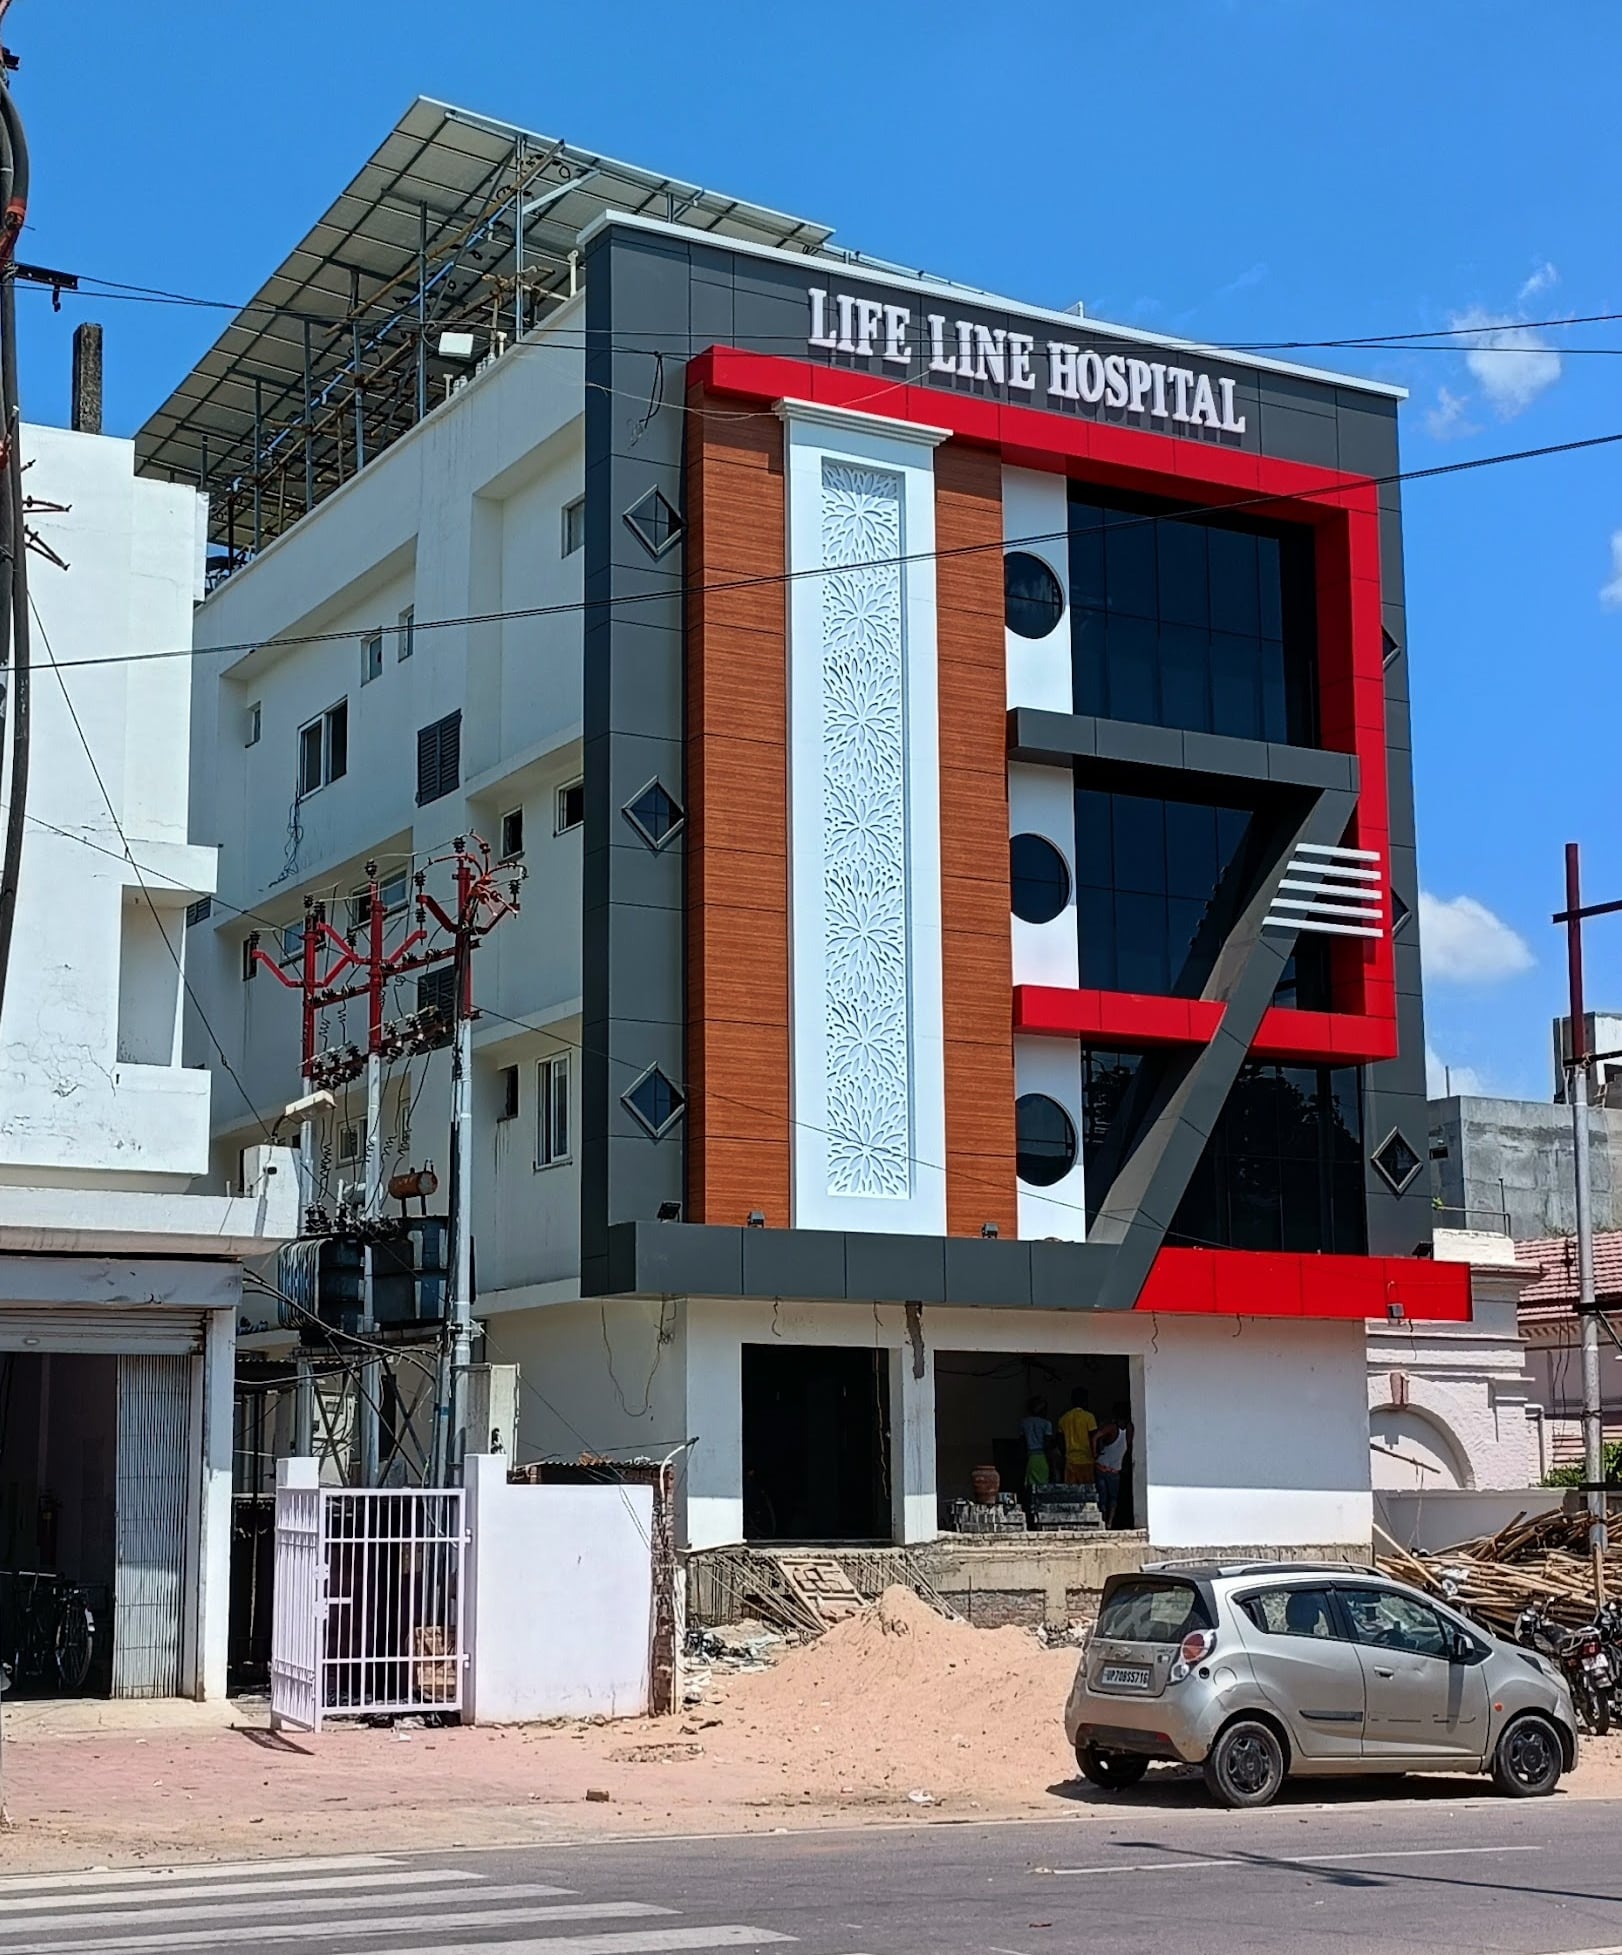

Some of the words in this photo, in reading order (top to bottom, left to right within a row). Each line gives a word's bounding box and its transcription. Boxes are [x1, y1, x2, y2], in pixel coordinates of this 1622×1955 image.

[808, 288, 911, 363] LIFE
[928, 314, 1036, 389] LINE
[1047, 340, 1246, 433] HOSPITAL
